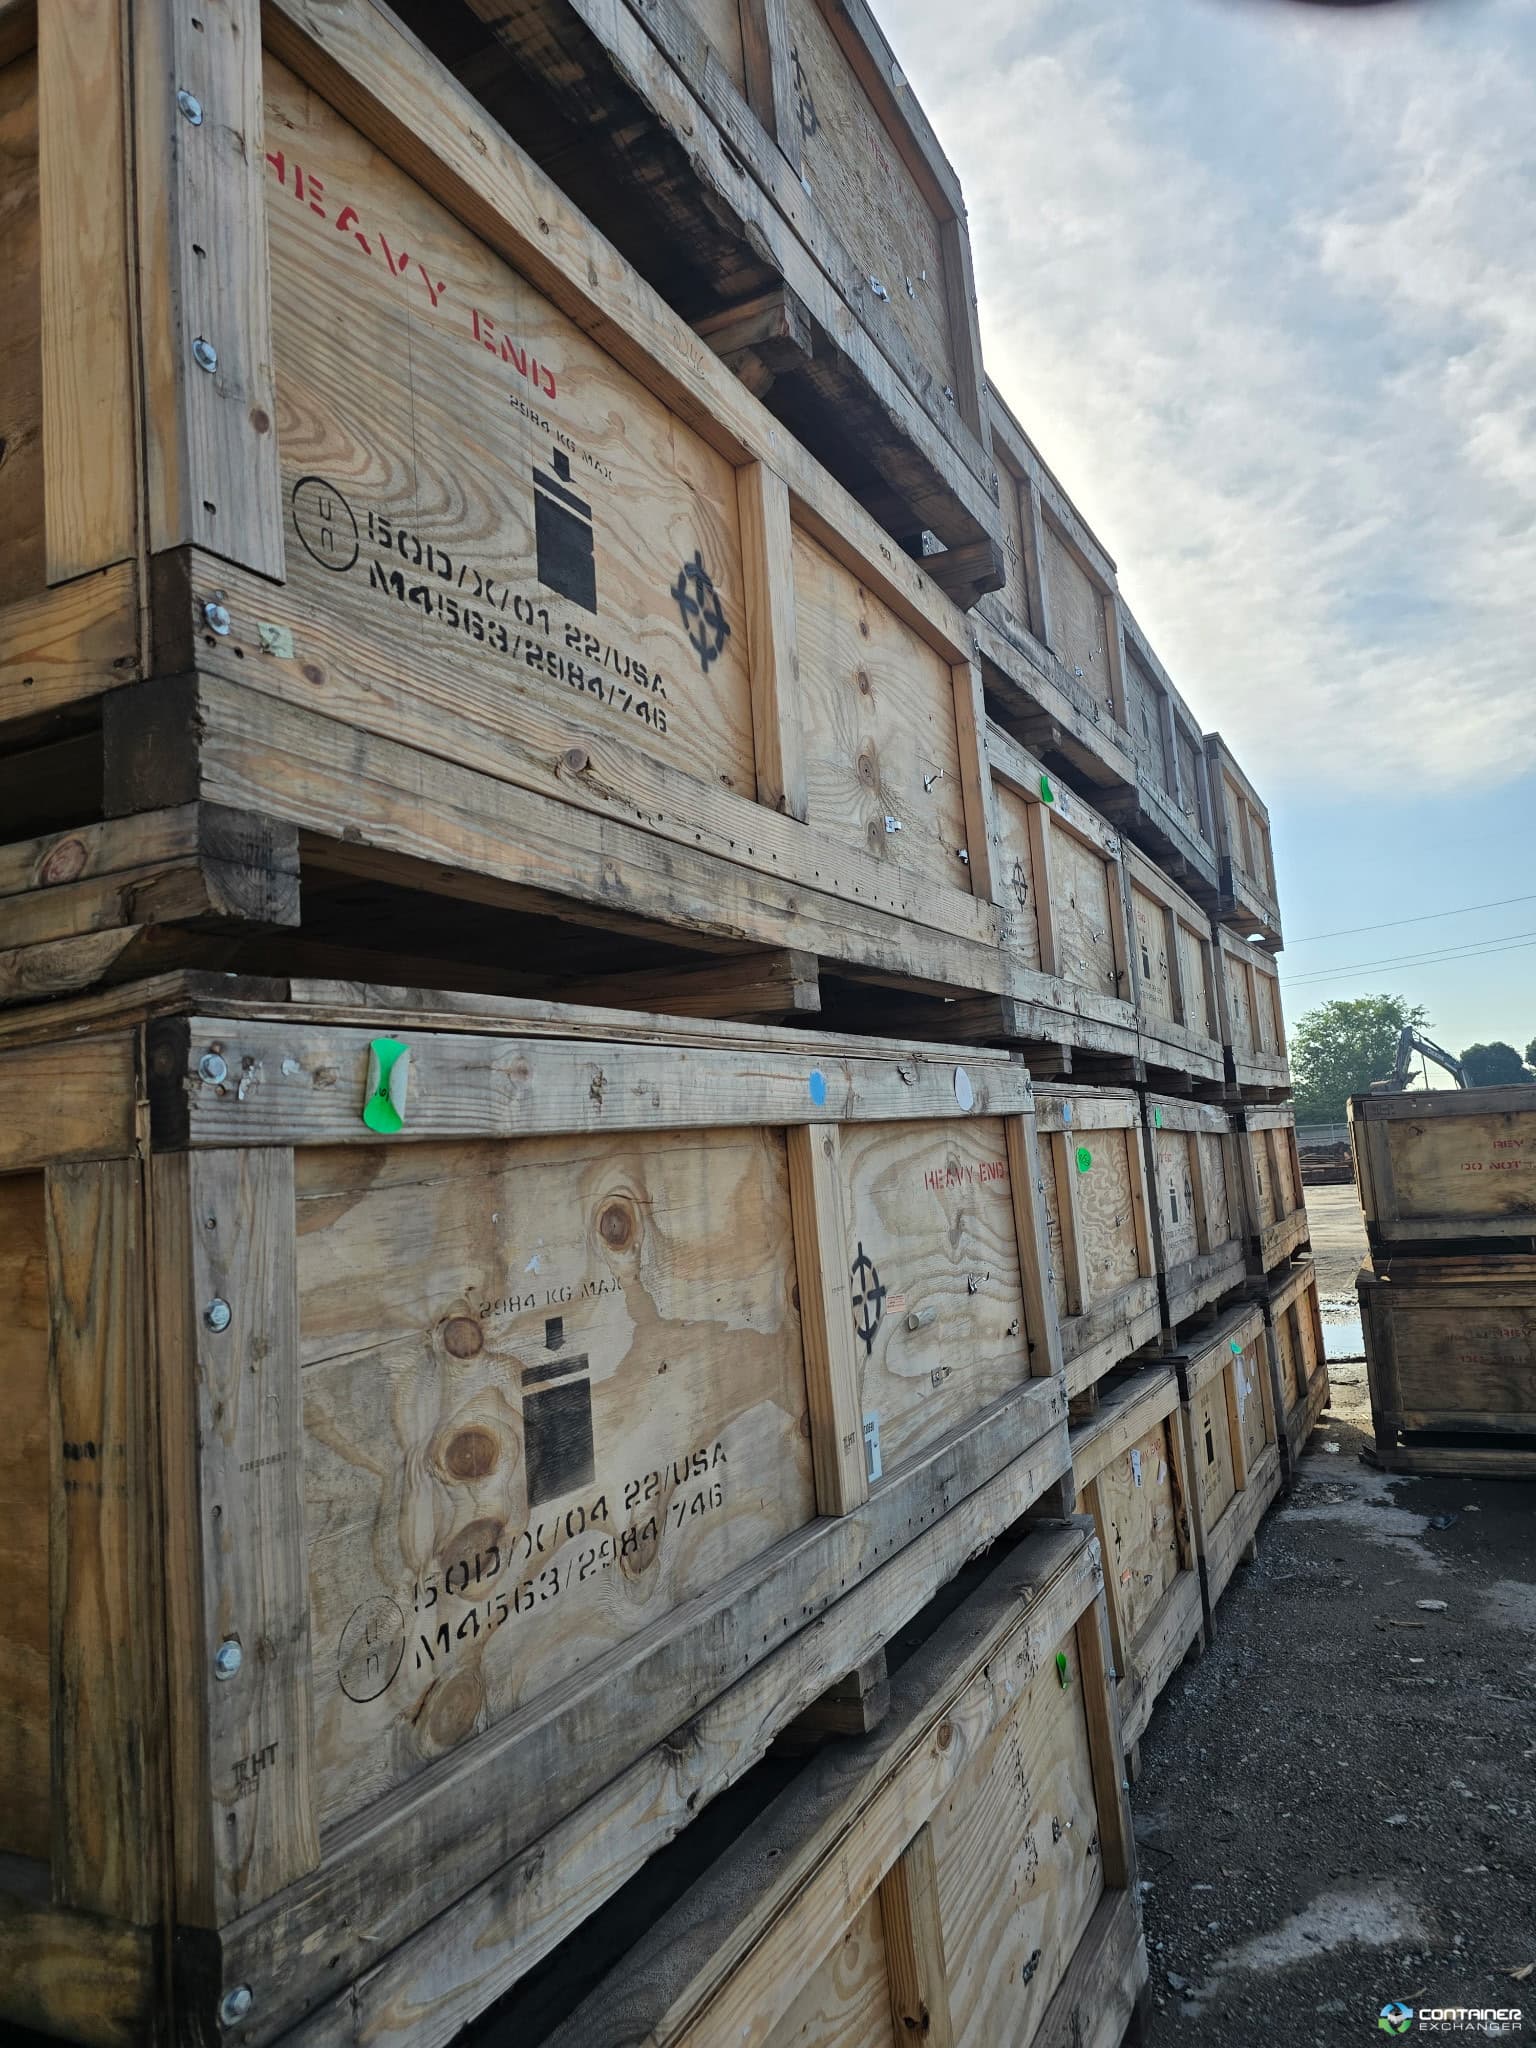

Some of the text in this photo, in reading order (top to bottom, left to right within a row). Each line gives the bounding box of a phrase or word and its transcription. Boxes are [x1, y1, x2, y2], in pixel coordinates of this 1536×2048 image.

[264, 149, 446, 308] HEAVY
[472, 307, 557, 400] END
[556, 429, 576, 453] KG
[581, 450, 614, 482] MAX
[564, 622, 667, 700] 22/USA
[924, 1160, 1004, 1191] HEAVY END
[1461, 1161, 1483, 1172] DO
[1489, 1159, 1521, 1171] NOT
[479, 1275, 622, 1320] 2984 KG MAX
[624, 1442, 727, 1511] 22/USA
